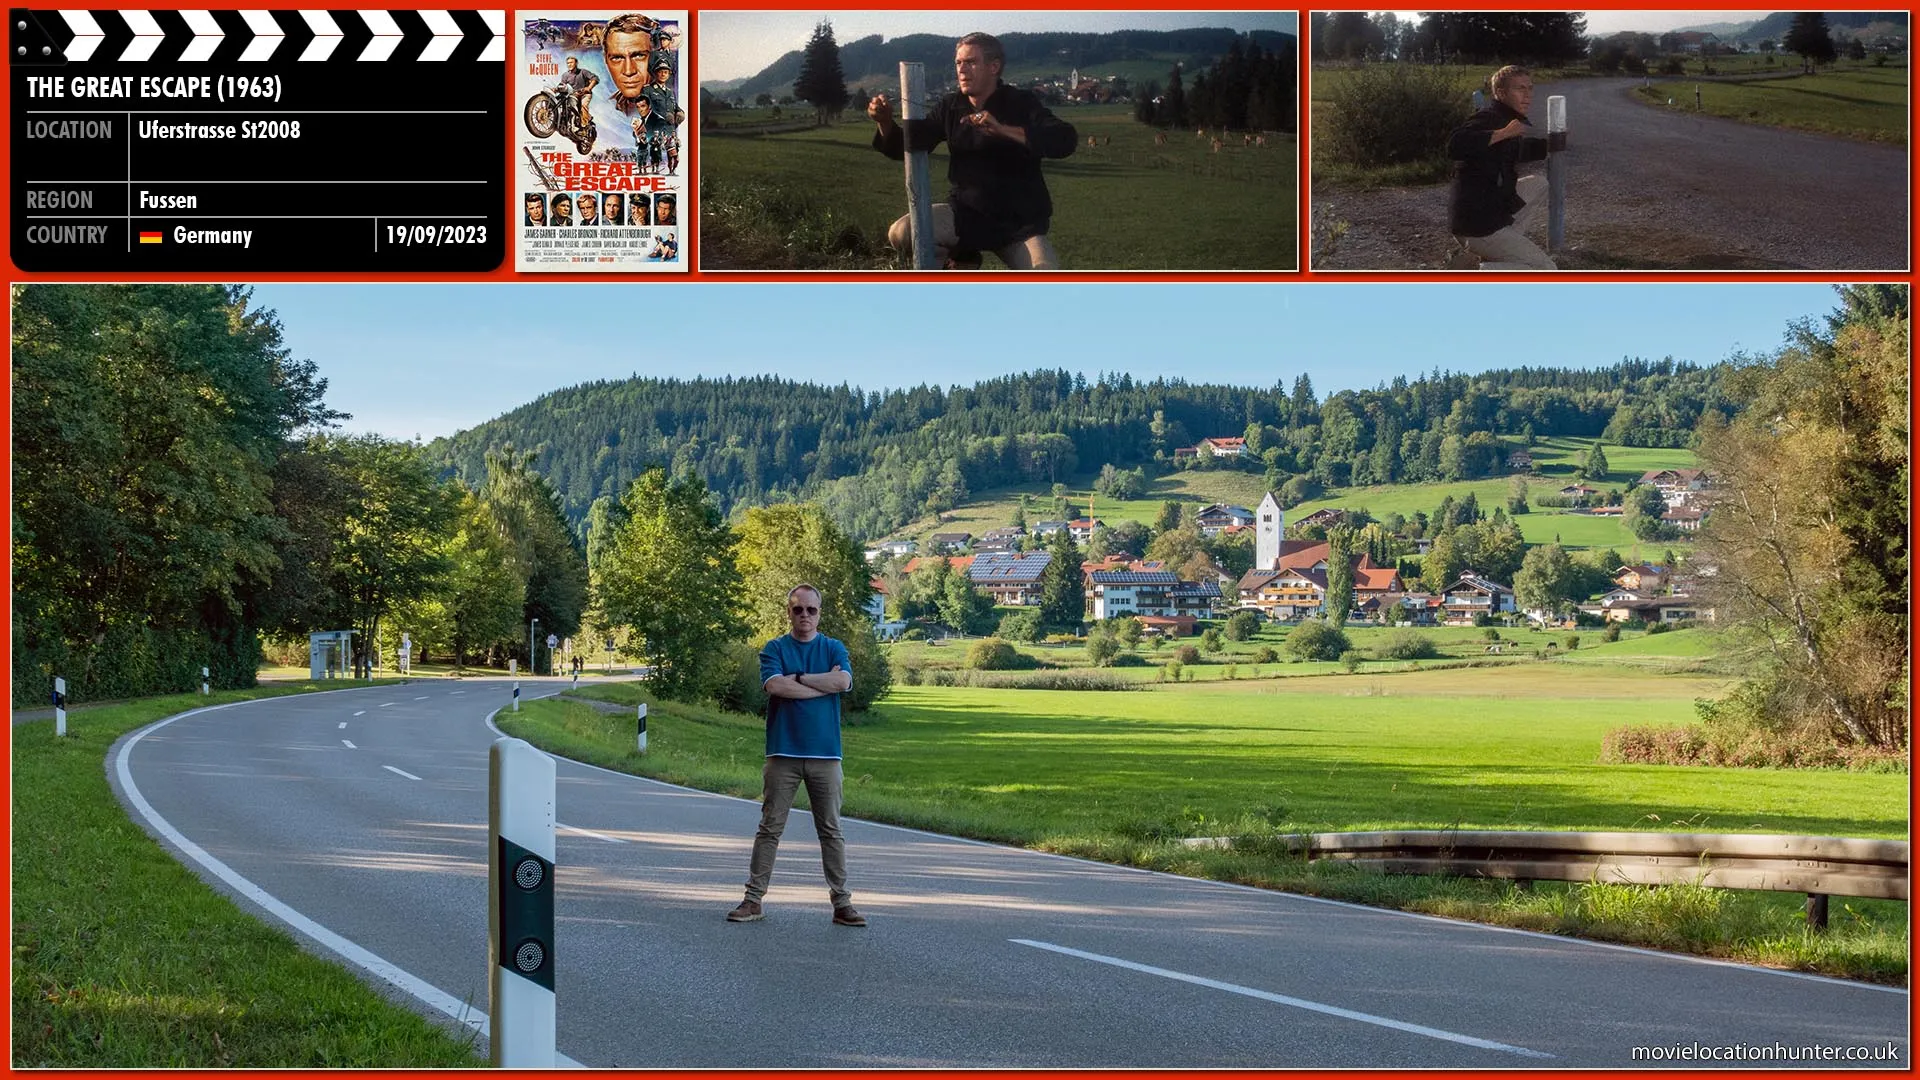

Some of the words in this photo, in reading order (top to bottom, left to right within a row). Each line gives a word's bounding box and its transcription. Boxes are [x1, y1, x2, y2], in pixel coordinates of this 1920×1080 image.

[536, 54, 552, 63] STEVE
[529, 63, 559, 76] McQUEEN
[540, 152, 572, 162] THE
[553, 162, 638, 177] GREAT
[565, 177, 666, 191] ESCAPE
